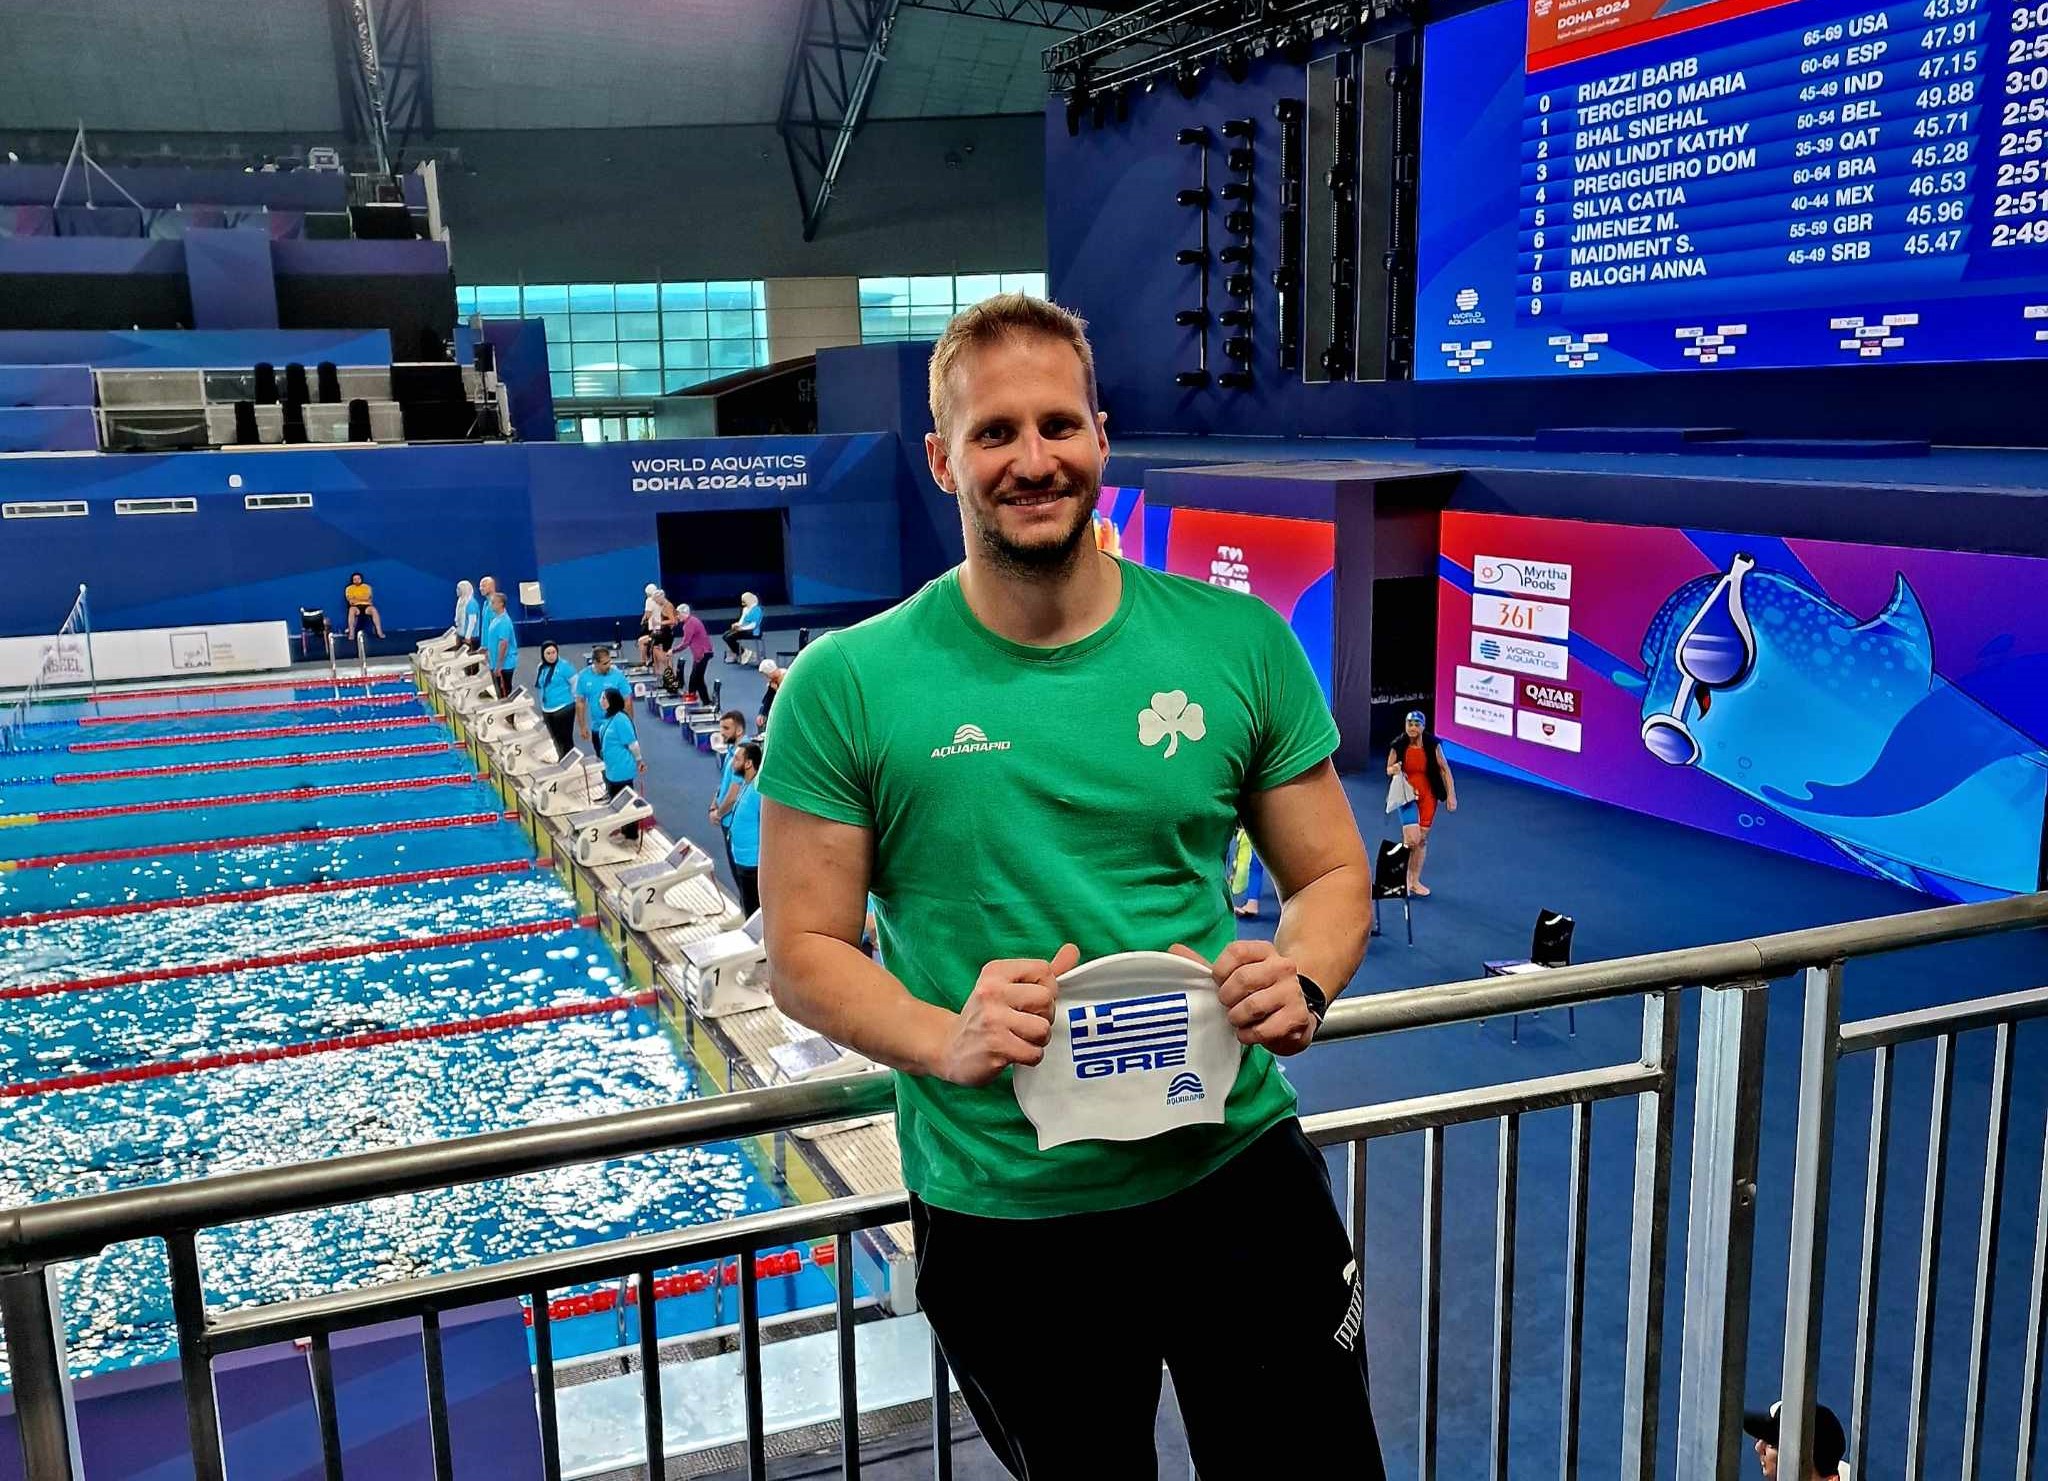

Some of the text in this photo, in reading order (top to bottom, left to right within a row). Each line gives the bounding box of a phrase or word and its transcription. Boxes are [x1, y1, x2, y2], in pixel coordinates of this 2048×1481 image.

[1557, 10, 1594, 30] DOHA
[1595, 1, 1630, 18] 2024
[1539, 95, 1550, 113] 0
[1578, 71, 1637, 103] RIAZZI
[1641, 57, 1698, 87] BARB
[1803, 24, 1843, 47] 65-69
[1848, 12, 1889, 38] USA
[1540, 118, 1549, 135] 1
[1577, 90, 1672, 126] TERCEIRO
[1677, 71, 1746, 104] MARIA
[1801, 53, 1840, 75] 60-64
[1846, 41, 1888, 67] ESP
[1920, 20, 1976, 49] 47.91
[1536, 141, 1548, 158] 2
[1575, 123, 1624, 150] BHAL
[1628, 107, 1708, 139] SNEHAL
[1799, 81, 1838, 102] 45-49
[1844, 70, 1884, 95] IND
[1918, 50, 1977, 79] 47.15
[1536, 164, 1547, 181] 3
[1575, 152, 1611, 173] VAN
[1615, 139, 1673, 166] LINDT
[1677, 123, 1749, 154] KATHY
[1841, 100, 1882, 123] BEL
[1915, 80, 1974, 109] 49.88
[1535, 98, 2048, 203] 4 PREGIGUEIRO DOM 35-39 QAT 45.71 2:5
[1534, 209, 1545, 226] 5
[1573, 197, 1623, 219] SILVA
[1627, 186, 1686, 211] CATIA
[1793, 164, 1831, 184] 60-64
[1837, 156, 1877, 179] BRA
[1911, 141, 1969, 168] 45.28
[1534, 231, 1544, 248] 6
[1571, 215, 1652, 243] JIMENEZ
[1656, 212, 1679, 231] M.
[1791, 193, 1829, 211] 40-44
[1835, 184, 1875, 207] MEX
[1908, 171, 1967, 197] 46.53
[1534, 254, 1543, 270] 7
[1571, 237, 1672, 266] MAIDMENT
[1676, 235, 1695, 253] S.
[1789, 220, 1828, 239] 55-59
[1833, 213, 1874, 234] GBR
[1906, 200, 1964, 225] 45.96
[1532, 276, 1542, 293] 8
[1569, 265, 1646, 289] BALOGH
[1650, 257, 1707, 281] ANNA
[1787, 247, 1826, 265] 45-49
[1831, 241, 1871, 261] SRB
[1904, 230, 1962, 255] 45.47
[1531, 298, 1542, 315] 9
[632, 454, 806, 473] WORLD AQUATICS
[632, 475, 750, 492] DOHA 2024
[754, 472, 807, 491] الدوحة
[1524, 565, 1568, 581] Myrtha
[1524, 577, 1556, 591] Pools
[1506, 645, 1545, 659] WORLD
[1505, 654, 1559, 670] AQUATICS
[1525, 685, 1574, 705] QATAR
[486, 714, 495, 726] 6
[514, 744, 522, 756] 5
[930, 741, 1011, 759] AQUARAPID
[548, 782, 557, 794] 4
[590, 828, 598, 843] 3
[645, 888, 655, 904] 2
[713, 968, 720, 986] 1
[1076, 1048, 1186, 1079] GRE
